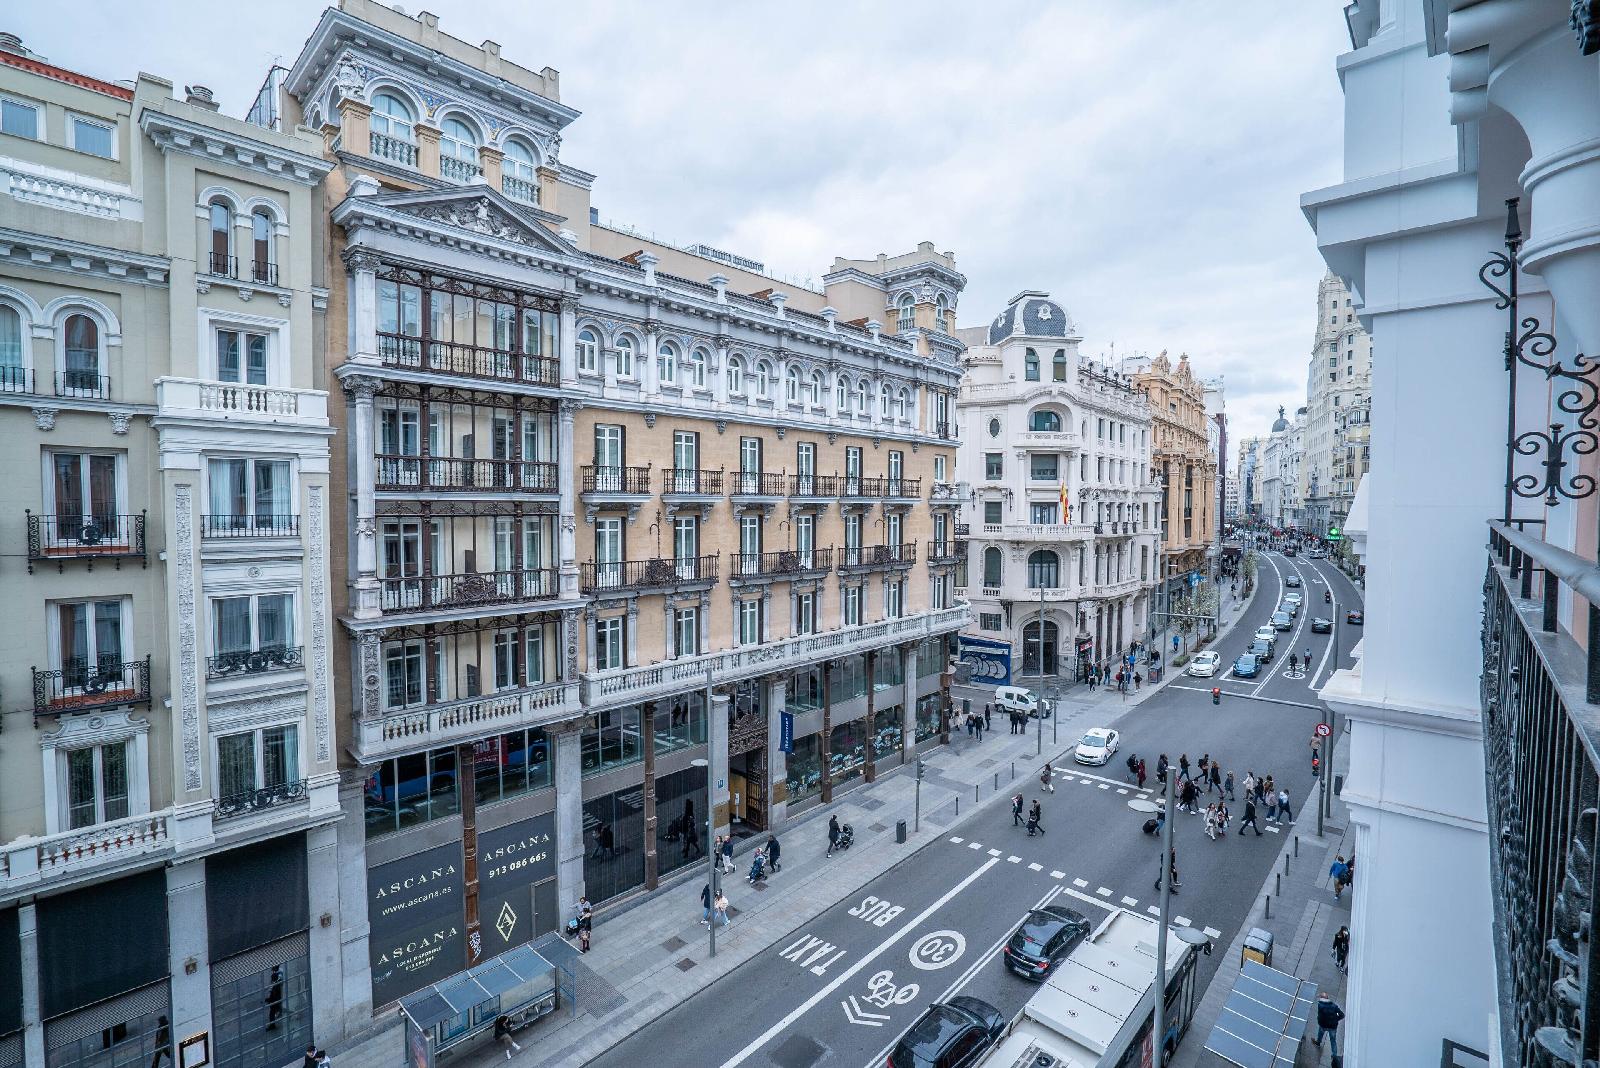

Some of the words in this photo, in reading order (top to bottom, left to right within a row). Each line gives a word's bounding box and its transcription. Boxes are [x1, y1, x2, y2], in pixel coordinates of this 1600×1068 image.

[484, 833, 550, 862] ASCANA
[489, 867, 507, 878] 913
[509, 860, 527, 871] 086
[530, 852, 547, 864] 665
[375, 865, 456, 899] ASCANA
[382, 886, 452, 916] www.ascana.es
[848, 896, 905, 927] BUS
[378, 927, 457, 965] ASCANA
[779, 934, 847, 976] TAXI
[920, 939, 954, 961] 30
